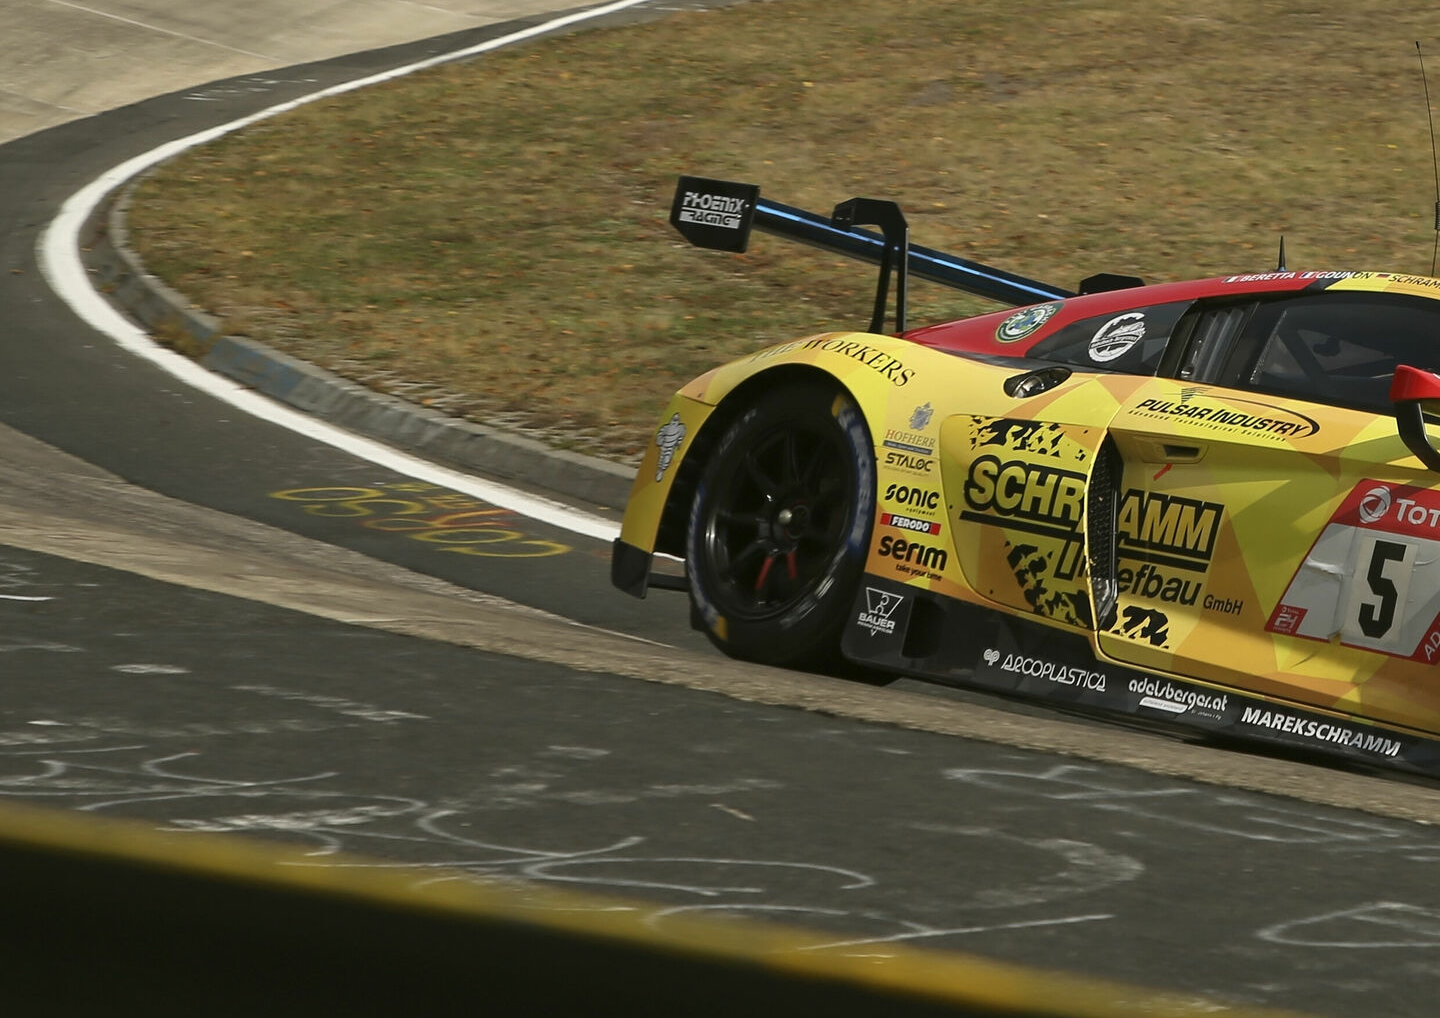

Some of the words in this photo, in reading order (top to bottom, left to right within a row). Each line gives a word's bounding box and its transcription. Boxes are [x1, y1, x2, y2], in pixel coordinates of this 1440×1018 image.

[682, 191, 745, 214] PHOENIX
[1240, 271, 1296, 282] BERETTA
[1314, 270, 1373, 281] GOUNON
[803, 339, 916, 387] WORKERS
[1136, 398, 1211, 422] PULSAR
[1208, 408, 1310, 437] INDUSTRY
[885, 429, 937, 448] HOFHERR
[884, 451, 934, 473] STALOC
[891, 516, 931, 532] FERODO
[878, 535, 948, 572] serim
[1358, 539, 1407, 640] 5
[1202, 594, 1244, 616] GmbH
[858, 612, 896, 630] BAUER
[1001, 653, 1107, 693] ARCOPLASTICA
[1128, 677, 1228, 712] adelsberger.at
[1241, 707, 1402, 757] MAREKSCHRAMM
